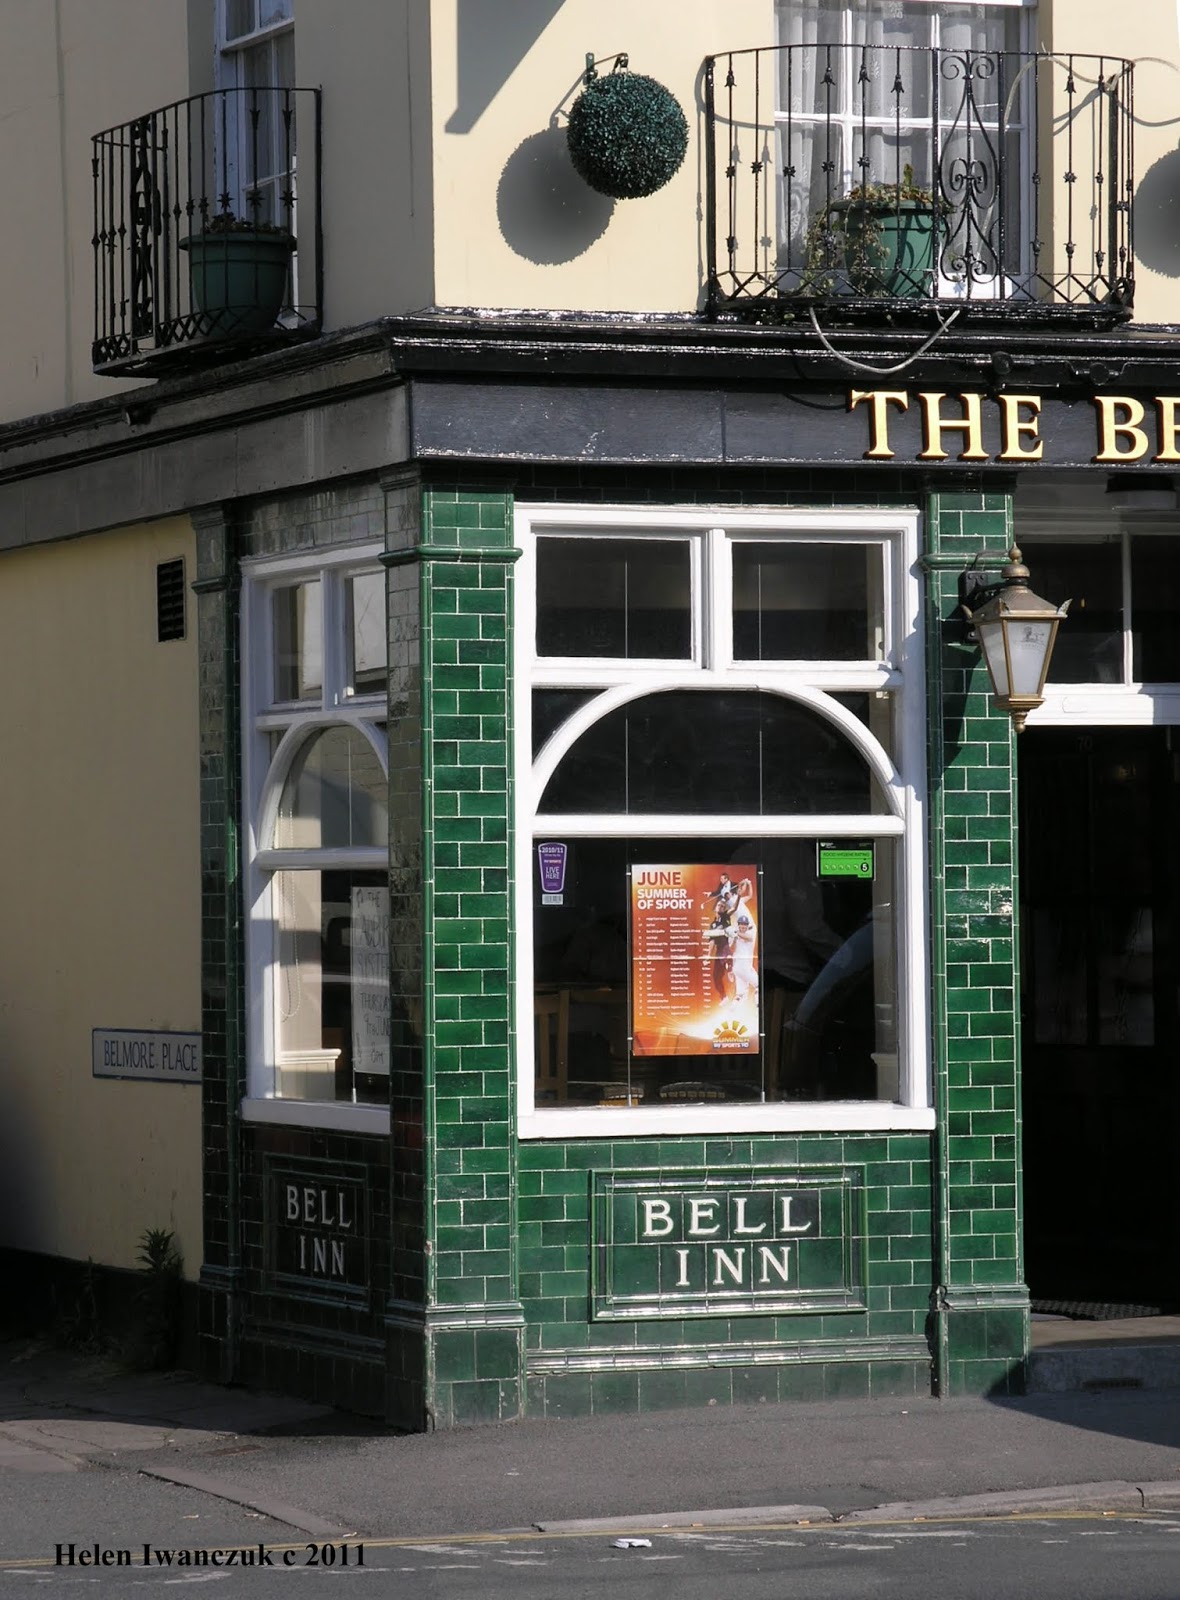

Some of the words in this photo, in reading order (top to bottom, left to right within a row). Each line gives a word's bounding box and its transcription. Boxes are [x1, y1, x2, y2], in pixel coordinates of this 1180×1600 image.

[850, 390, 1044, 461] THE
[637, 871, 681, 886] JUNE
[862, 863, 868, 871] 5
[637, 888, 687, 899] SUMMER
[637, 899, 654, 910] OF
[655, 899, 694, 910] SPORT
[104, 1040, 155, 1069] BELMORE
[162, 1043, 198, 1072] PLACE
[286, 1184, 352, 1228] BELL
[642, 1196, 812, 1236] BELL
[300, 1235, 345, 1275] INN
[676, 1246, 791, 1286] INN
